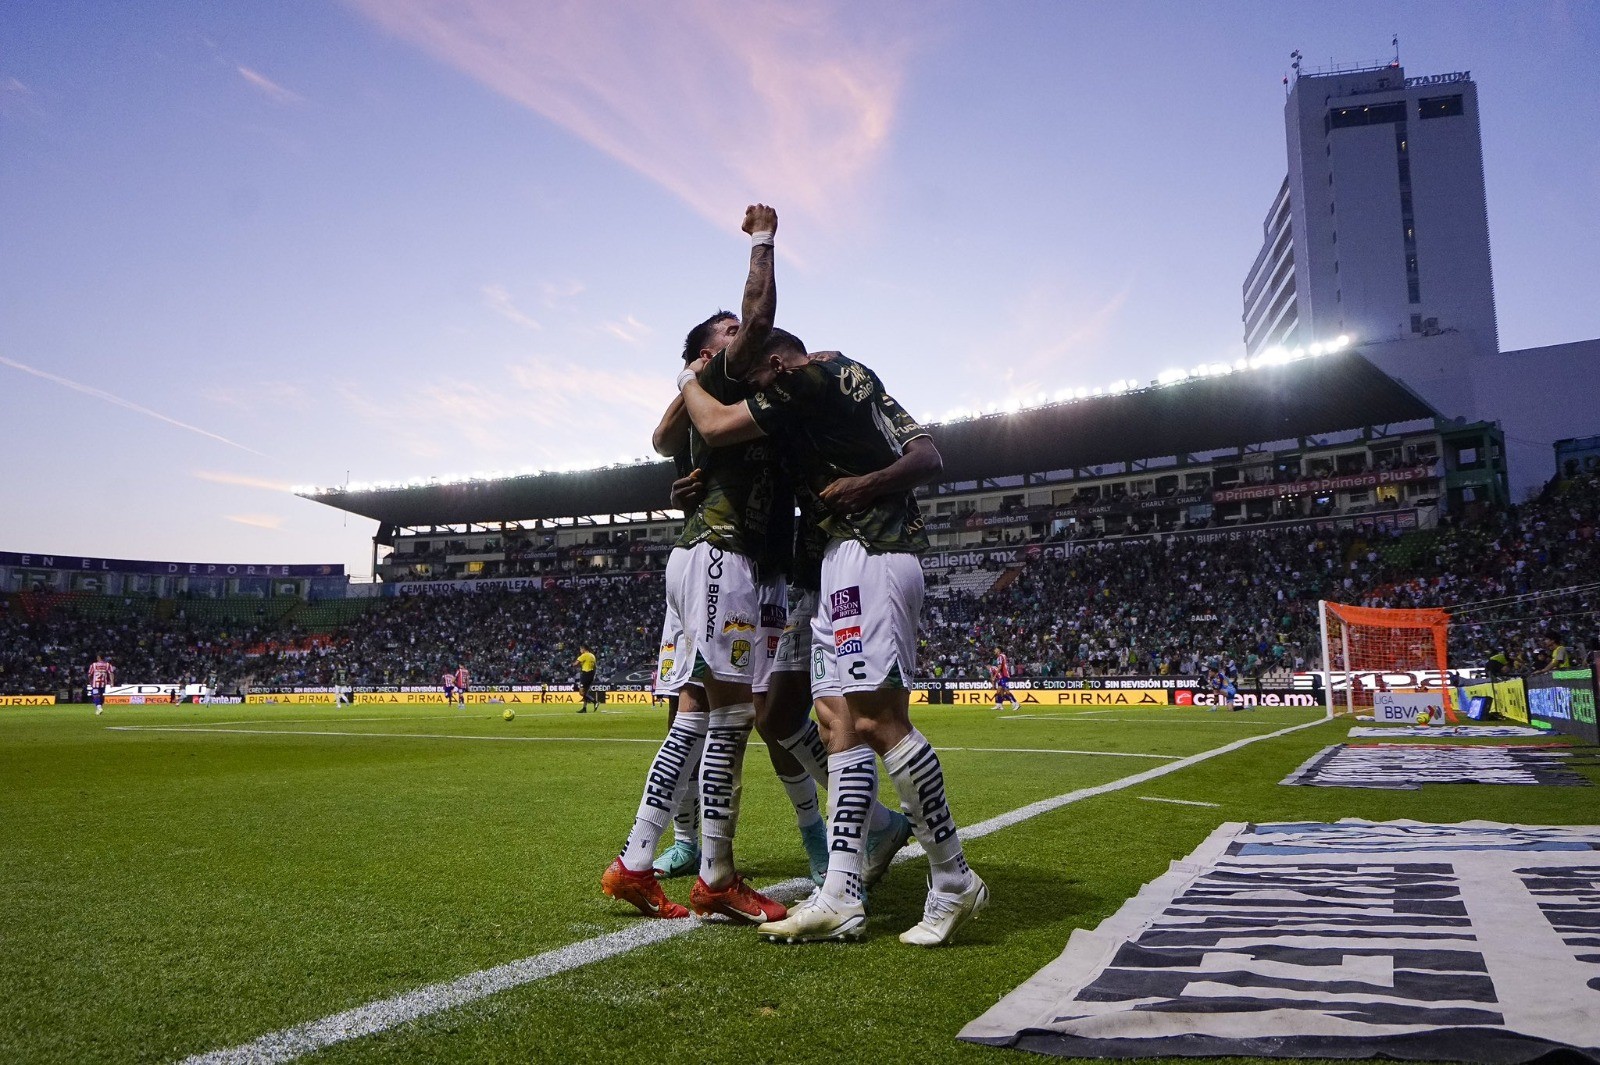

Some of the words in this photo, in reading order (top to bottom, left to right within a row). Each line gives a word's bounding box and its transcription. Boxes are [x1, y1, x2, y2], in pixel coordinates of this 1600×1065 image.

[1225, 486, 1276, 501] Primera
[1278, 483, 1308, 495] Plus
[1321, 476, 1376, 490] Primera
[1379, 470, 1412, 483] Plus
[1141, 500, 1165, 508] CHARLY
[1176, 495, 1202, 504] CHARLY
[1056, 509, 1078, 517] CHARLY
[1088, 505, 1111, 514] CHARLY
[983, 513, 1029, 526] caliente.mx
[523, 551, 557, 560] caliente.mx
[21, 555, 54, 567] EN
[82, 559, 110, 570] EL
[168, 563, 289, 576] DEPORTE
[834, 590, 850, 607] HS
[705, 584, 720, 643] BROXEL
[1190, 614, 1218, 622] SALIDA
[813, 648, 826, 680] 8
[912, 682, 942, 690] DIRECTO
[944, 682, 958, 690] SIN
[1009, 680, 1031, 690] BURÓ
[1104, 681, 1119, 689] SIN
[1121, 678, 1161, 689] REVISIÓN
[1162, 680, 1175, 688] DE
[299, 695, 330, 703] PIRMA
[407, 695, 444, 703] PIRMA
[1058, 693, 1129, 705] PIRMA
[1374, 695, 1394, 705] LIGA
[1384, 706, 1419, 719] BBVA
[645, 732, 697, 813] PERDURA
[703, 732, 741, 820] PERDURA
